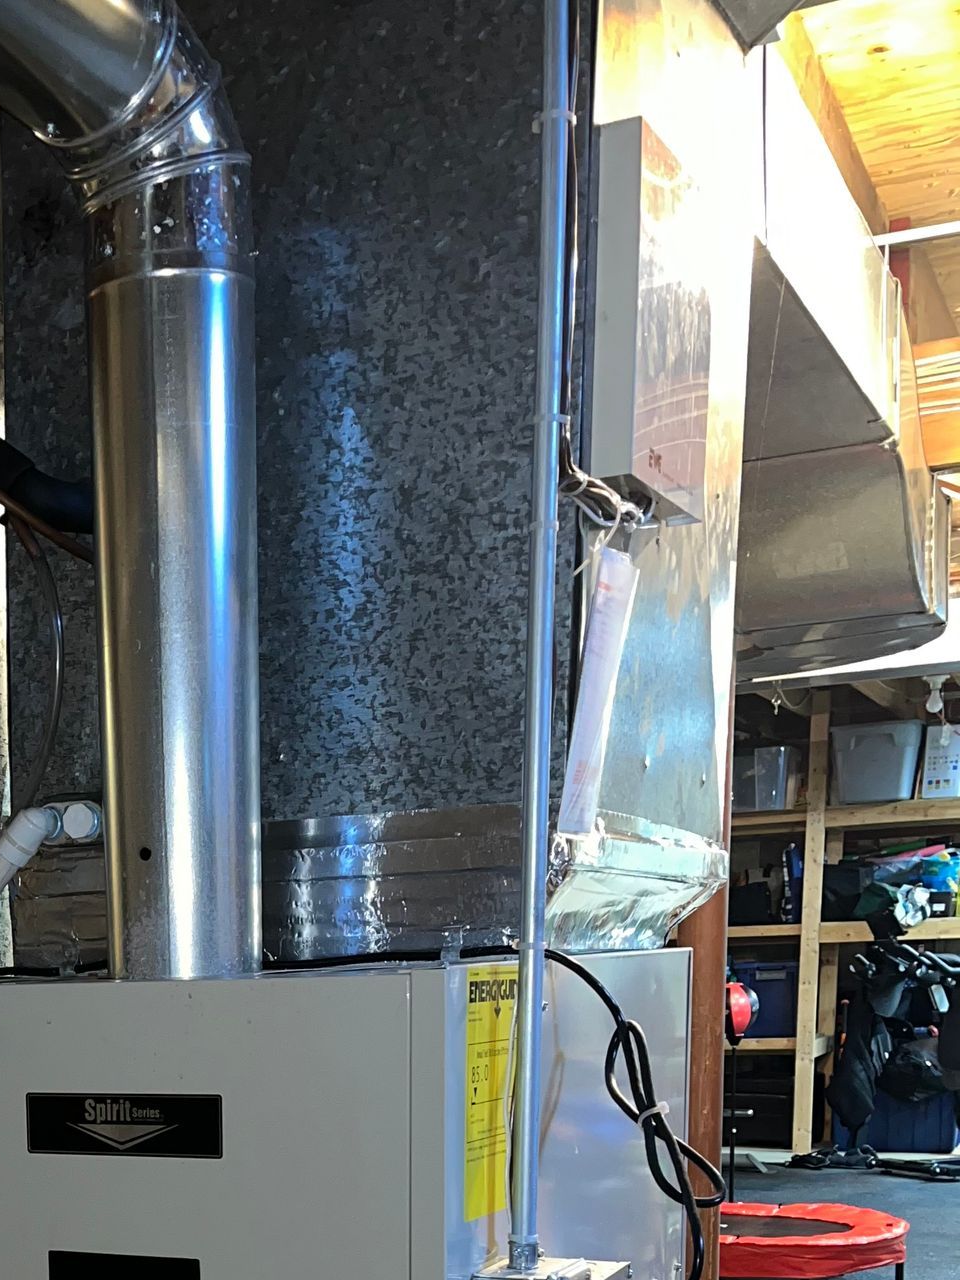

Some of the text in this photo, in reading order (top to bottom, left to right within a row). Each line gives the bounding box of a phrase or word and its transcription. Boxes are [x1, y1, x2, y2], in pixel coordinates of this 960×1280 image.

[471, 1064, 489, 1084] 85.0
[84, 1098, 160, 1123] Spirit Series
